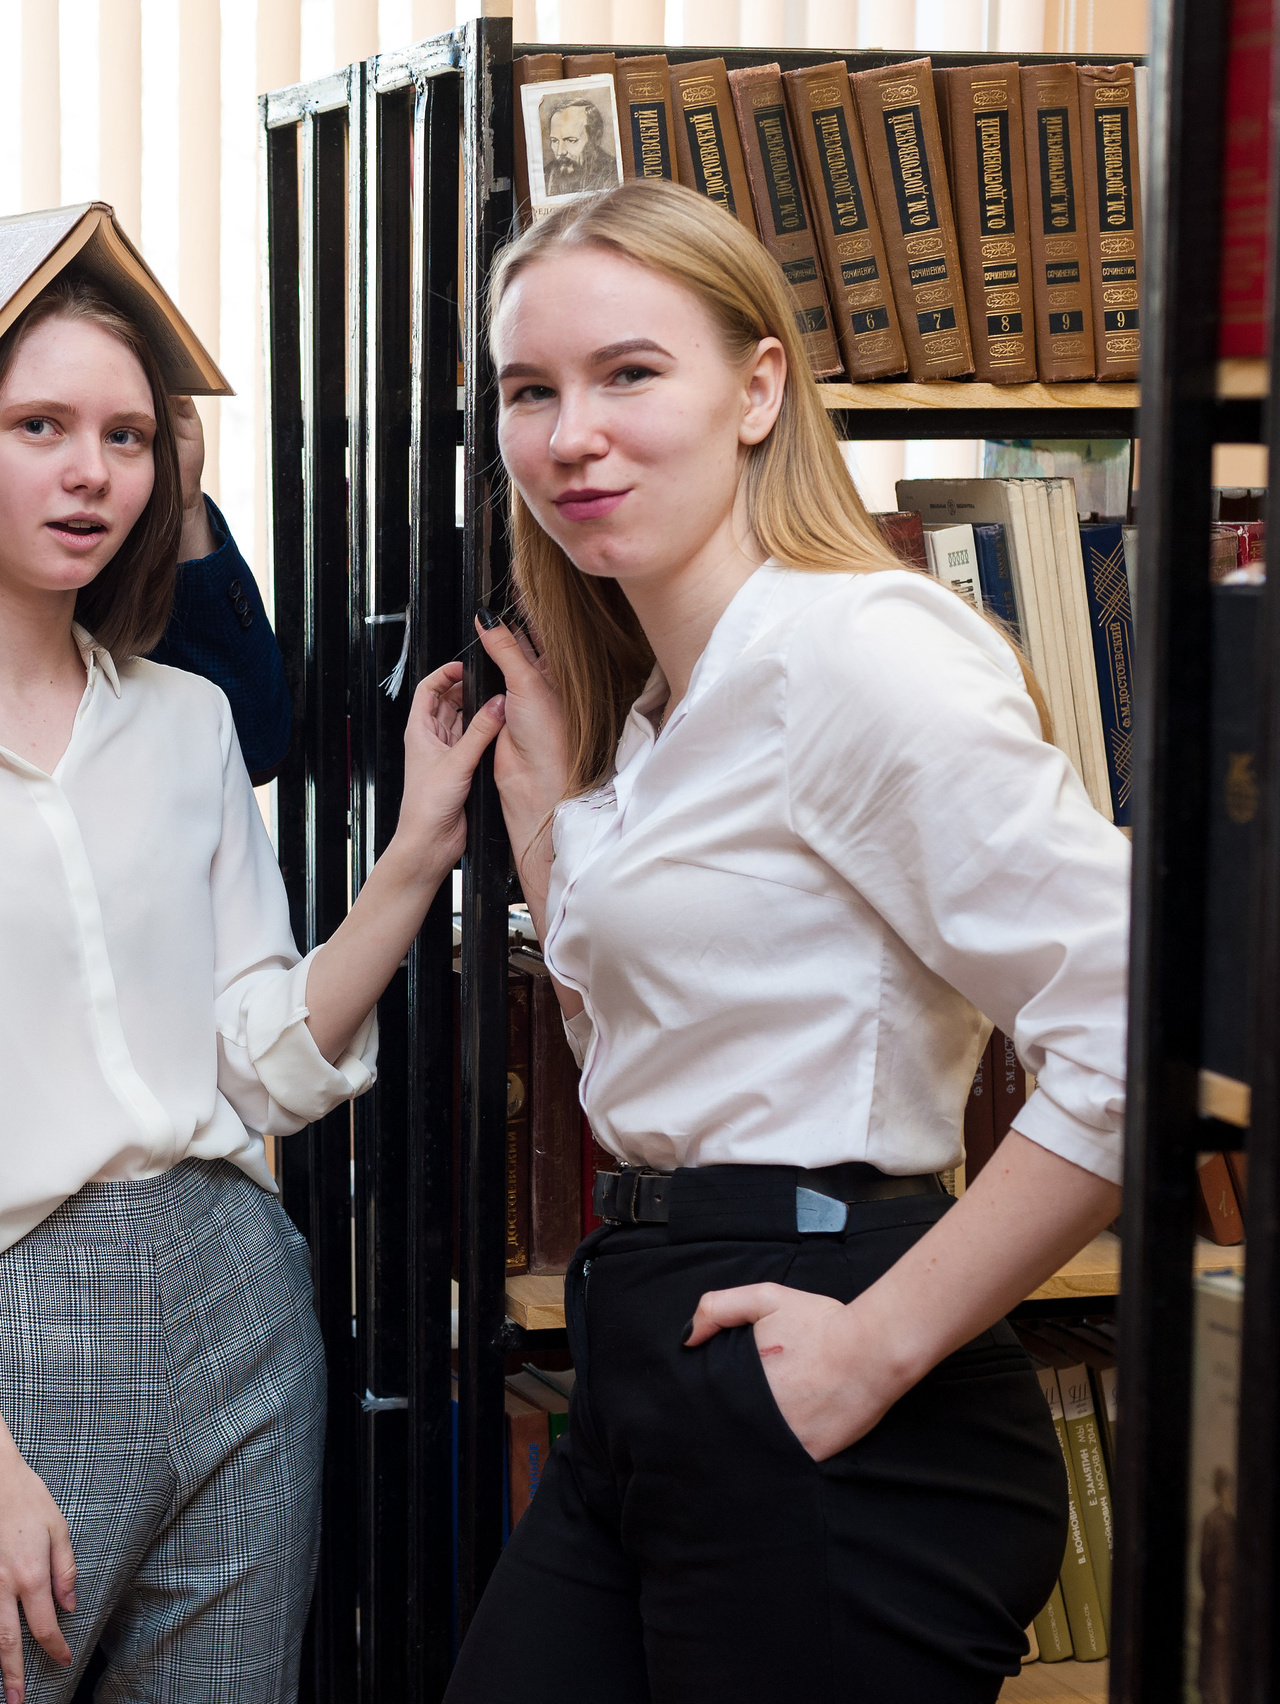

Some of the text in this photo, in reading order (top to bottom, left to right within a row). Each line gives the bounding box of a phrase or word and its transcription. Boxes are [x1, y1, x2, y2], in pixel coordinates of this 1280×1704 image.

[634, 108, 663, 179] СТОЕВСКИЙ
[842, 265, 876, 280] СОЧИНЕНИЯ
[911, 264, 946, 279] СОЧИНЕНИЯ
[984, 269, 1016, 281] СОЧИНЕНИЯ
[1047, 268, 1078, 278] СОЧИНЕНИЯ
[1102, 265, 1135, 276] СОЧИНЕНИЯ
[807, 314, 816, 331] 5
[865, 312, 875, 330] 6
[932, 312, 941, 330] 7
[1001, 315, 1010, 332] 8
[1062, 313, 1070, 331] 9
[1116, 311, 1126, 328] 9
[1075, 1424, 1085, 1443] МЫ
[1086, 1422, 1097, 1445] 2042
[528, 1442, 540, 1499] РАННОЕ
[1080, 1449, 1097, 1495] ЗАМЯТИН
[1091, 1446, 1105, 1490] МОСКВА
[1089, 1497, 1098, 1507] Е.
[1069, 1500, 1084, 1555] ВОЙНОВИЧ
